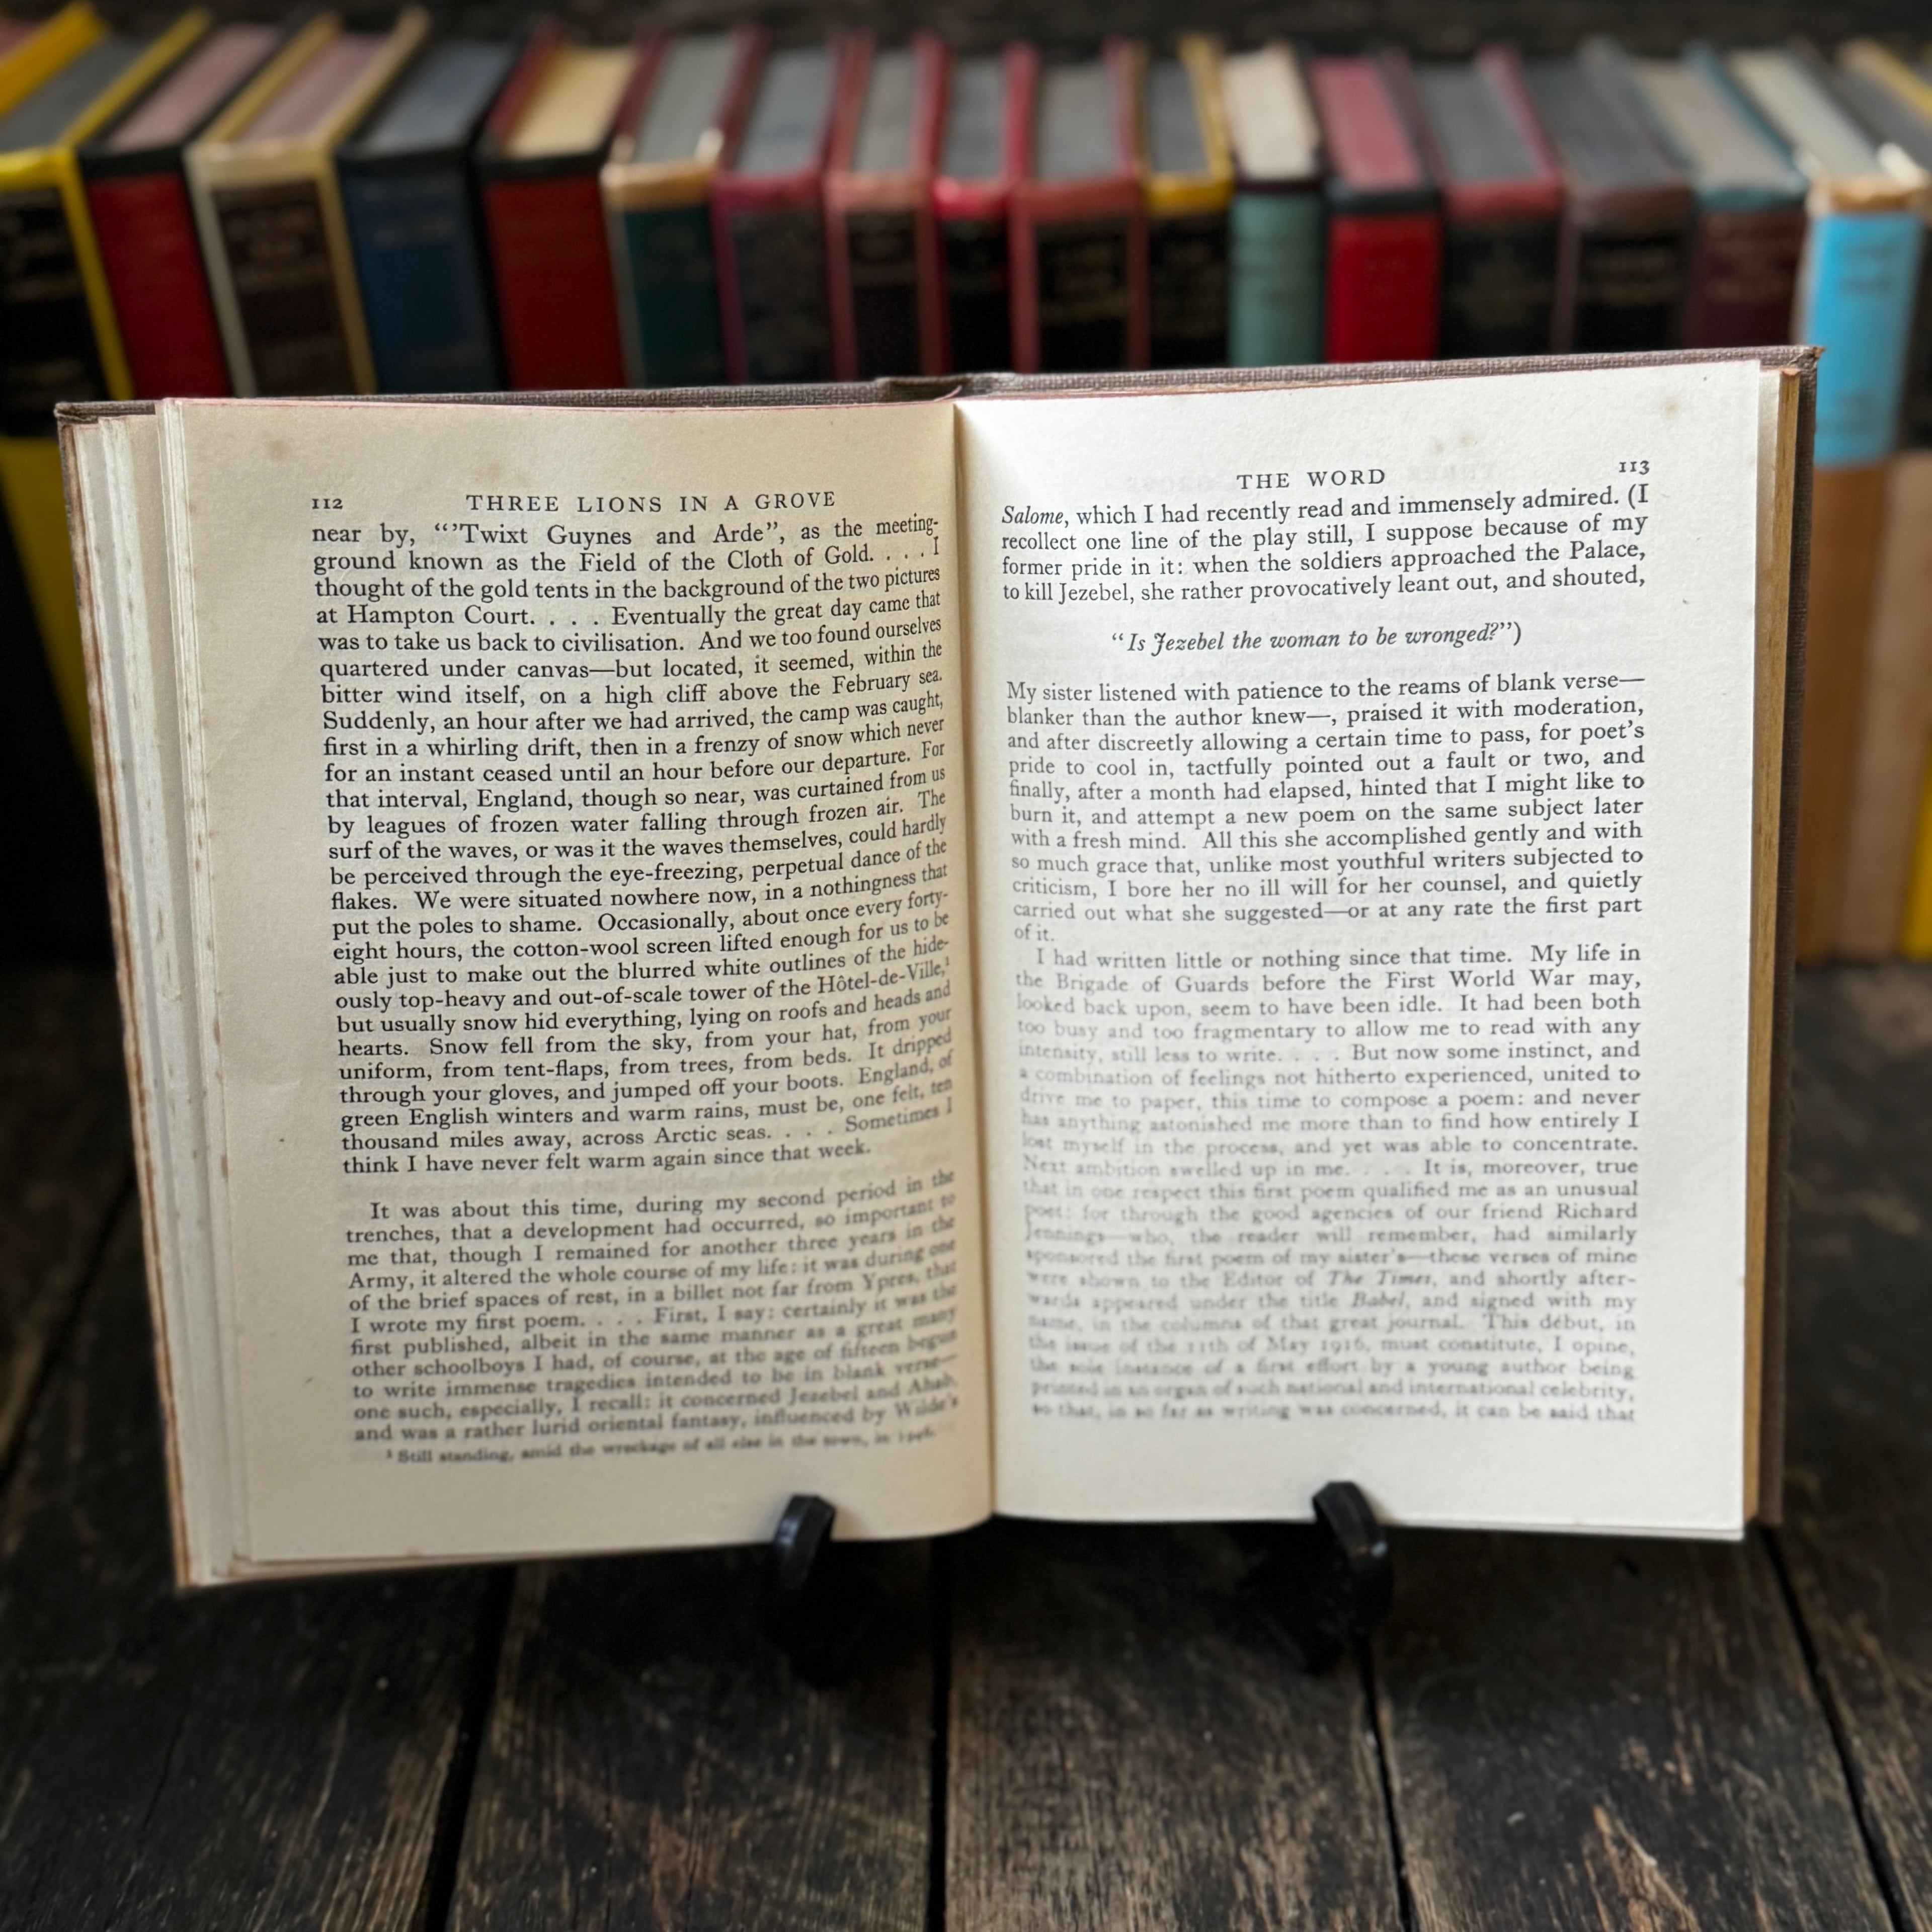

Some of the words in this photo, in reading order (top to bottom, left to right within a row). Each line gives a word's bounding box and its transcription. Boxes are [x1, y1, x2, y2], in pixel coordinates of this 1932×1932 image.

[1236, 472, 1290, 490] THE
[1307, 469, 1385, 487] WORD
[1619, 460, 1650, 475] 113
[311, 498, 343, 510] 112
[465, 495, 558, 512] THREE
[577, 497, 661, 513] LIONS
[680, 496, 707, 512] IN
[723, 495, 739, 511] A
[755, 491, 835, 510] GROVE
[1001, 505, 1069, 528] Salome,
[1076, 504, 1137, 525] which
[1143, 504, 1154, 523] I
[1161, 503, 1199, 523] had
[1206, 500, 1291, 525] recently
[1298, 498, 1343, 518] read
[1351, 496, 1391, 516] and
[1398, 490, 1516, 516] immensely
[1522, 485, 1619, 509] admired.
[1628, 483, 1649, 510] (I
[312, 528, 362, 542] near
[379, 522, 415, 549] by,
[547, 524, 632, 550] Guynes
[656, 524, 696, 544] and
[801, 526, 820, 540] as
[834, 517, 862, 537] the
[876, 512, 939, 536] meeting-
[317, 637, 360, 651] was
[366, 634, 388, 650] to
[394, 631, 440, 651] take
[446, 637, 471, 651] us
[477, 631, 528, 651] back
[533, 636, 555, 652] to
[562, 632, 684, 652] civilisation.
[698, 629, 742, 650] And
[749, 634, 776, 648] we
[781, 631, 812, 646] too
[817, 621, 871, 644] found
[875, 616, 941, 639] ourselves
[1151, 631, 1225, 657] Jezebel
[1233, 630, 1262, 649] the
[1269, 634, 1340, 649] woman
[1349, 630, 1368, 646] to
[1376, 626, 1397, 645] be
[324, 710, 435, 736] Suddenly,
[443, 717, 469, 730] an
[477, 710, 529, 730] hour
[536, 711, 586, 731] after
[592, 717, 622, 730] we
[629, 710, 668, 730] had
[675, 707, 755, 730] arrived,
[761, 705, 793, 725] the
[799, 706, 850, 725] camp
[855, 703, 887, 717] was
[892, 690, 943, 715] caught,
[1007, 705, 1074, 726] blanker
[1082, 707, 1126, 726] than
[1134, 708, 1166, 727] the
[1175, 707, 1243, 726] author
[1347, 701, 1423, 728] praised
[1431, 701, 1447, 719] it
[1456, 698, 1504, 718] with
[1513, 695, 1643, 716] moderation,
[326, 788, 370, 808] that
[378, 789, 467, 811] interval,
[476, 788, 573, 813] England,
[581, 787, 658, 812] though
[665, 792, 687, 806] so
[694, 791, 745, 807] near,
[753, 788, 790, 801] was
[797, 773, 884, 798] curtained
[890, 770, 926, 789] from
[931, 768, 945, 782] us
[330, 866, 355, 884] be
[364, 865, 468, 890] perceived
[475, 864, 561, 889] through
[569, 864, 602, 882] the
[610, 861, 743, 887] eye-freezing,
[752, 851, 844, 881] perpetual
[851, 850, 900, 868] dance
[906, 840, 922, 860] of
[926, 837, 946, 857] the
[1011, 857, 1029, 869] so
[1037, 854, 1089, 872] much
[1096, 861, 1148, 878] grace
[1155, 855, 1200, 877] that,
[1209, 855, 1272, 873] unlike
[1280, 857, 1329, 871] most
[1336, 850, 1425, 876] youthful
[1432, 853, 1506, 868] writers
[1513, 845, 1614, 870] subjected
[1621, 849, 1644, 863] to
[1035, 947, 1045, 964] I
[1053, 948, 1087, 967] had
[1096, 955, 1166, 969] written
[1176, 951, 1222, 969] little
[1231, 956, 1253, 968] or
[1262, 949, 1340, 972] nothing
[1349, 948, 1400, 965] since
[1410, 946, 1451, 964] that
[1460, 946, 1512, 963] time.
[1531, 944, 1568, 967] My
[1577, 942, 1611, 961] life
[1620, 943, 1641, 961] in
[336, 991, 392, 1013] ously
[398, 989, 506, 1013] top-heavy
[513, 988, 552, 1006] and
[559, 985, 682, 1005] out-of-scale
[689, 987, 747, 1001] tower
[753, 979, 775, 999] of
[778, 978, 811, 997] the
[343, 1155, 399, 1174] think
[407, 1155, 417, 1172] I
[426, 1154, 473, 1171] have
[481, 1158, 539, 1171] never
[546, 1151, 581, 1169] felt
[588, 1156, 646, 1169] warm
[653, 1154, 706, 1171] again
[713, 1147, 765, 1165] since
[771, 1143, 811, 1163] that
[818, 1138, 871, 1158] week.
[346, 1224, 440, 1244] trenches,
[451, 1223, 492, 1240] that
[502, 1228, 513, 1240] a
[523, 1221, 655, 1242] development
[665, 1217, 701, 1235] had
[711, 1212, 804, 1233] occurred,
[815, 1214, 836, 1228] so
[844, 1200, 934, 1228] important
